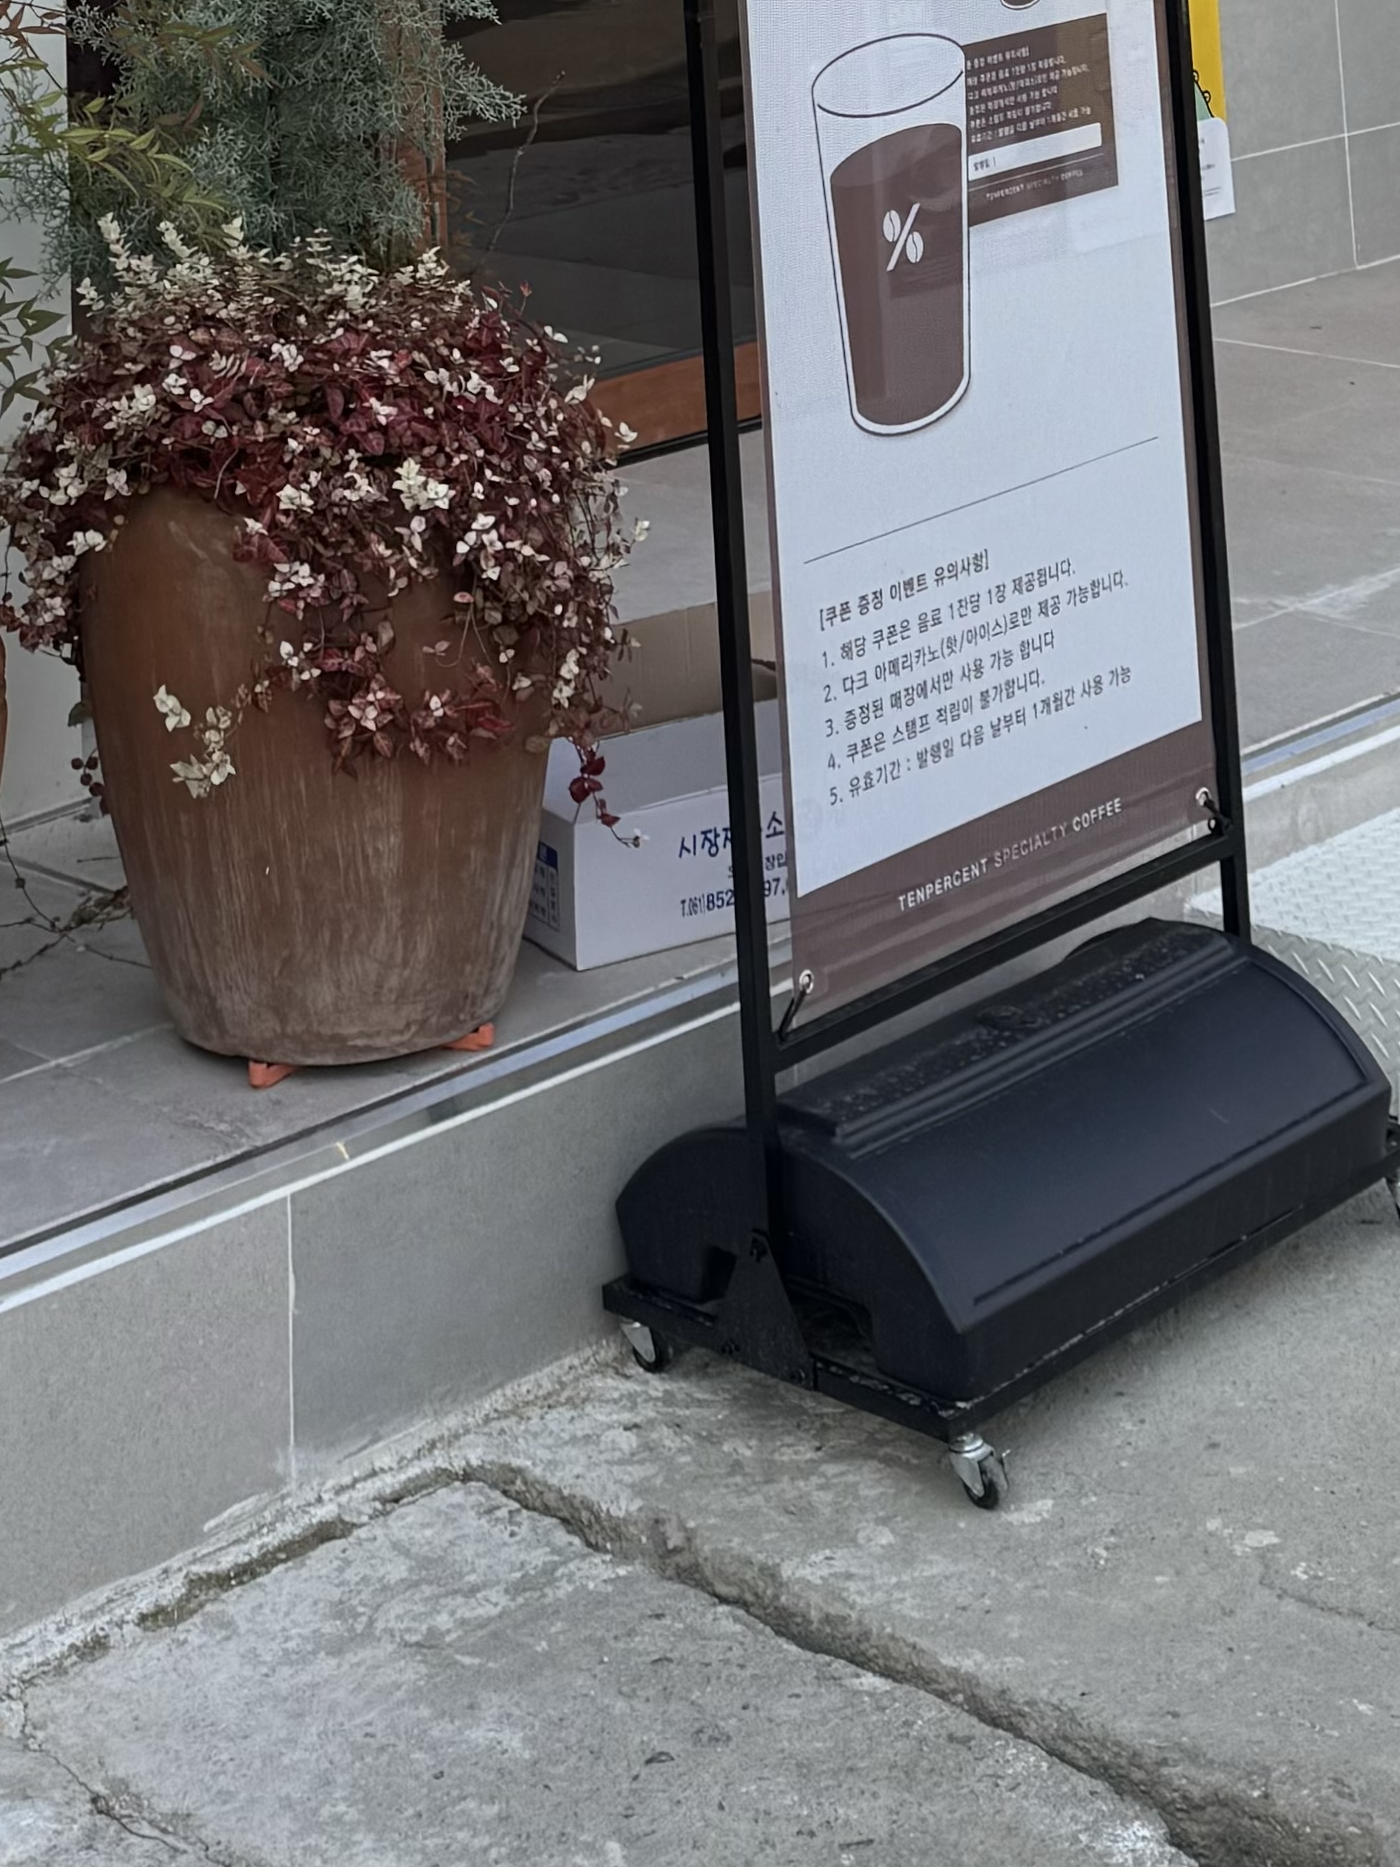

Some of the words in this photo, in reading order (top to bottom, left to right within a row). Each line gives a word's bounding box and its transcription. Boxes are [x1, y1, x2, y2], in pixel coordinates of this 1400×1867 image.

[819, 600, 851, 632] [쿠폰
[857, 591, 884, 617] 증정
[889, 572, 929, 602] 이벤트
[934, 548, 989, 588] 유의사항]
[822, 649, 835, 669] 1.
[840, 634, 867, 661] 해당
[872, 618, 911, 651] 쿠폰은
[917, 607, 944, 634] 음료
[948, 592, 982, 621] 1잔당
[987, 582, 1006, 606] 1장
[1011, 557, 1076, 597] 제공됩니다.
[823, 683, 837, 704] 2.
[842, 671, 869, 696] 다크
[1037, 594, 1061, 618] 제공
[1066, 568, 1129, 608] 가능합니다.
[825, 718, 839, 737] 3.
[844, 698, 884, 731] 증정된
[889, 669, 954, 712] 매장에서만
[960, 656, 984, 683] 사용
[990, 646, 1014, 672] 가능
[1019, 628, 1056, 661] 합니다
[827, 752, 841, 771] 4.
[846, 731, 886, 764] 쿠폰은
[892, 716, 931, 746] 스탬프
[936, 694, 974, 725] 적립이
[979, 666, 1045, 710] 불가합니다.
[830, 786, 843, 806] 5.
[848, 758, 902, 798] 유효기간
[916, 737, 955, 769] 발행일
[960, 723, 985, 750] 다음
[990, 705, 1027, 739] 날부터
[1032, 685, 1076, 720] 1개월간
[1080, 673, 1103, 699] 사용
[1108, 665, 1132, 688] 가능
[898, 857, 989, 913] TENPERCENT
[993, 821, 1069, 869] SPECIALTY
[1072, 796, 1123, 833] COFFEE
